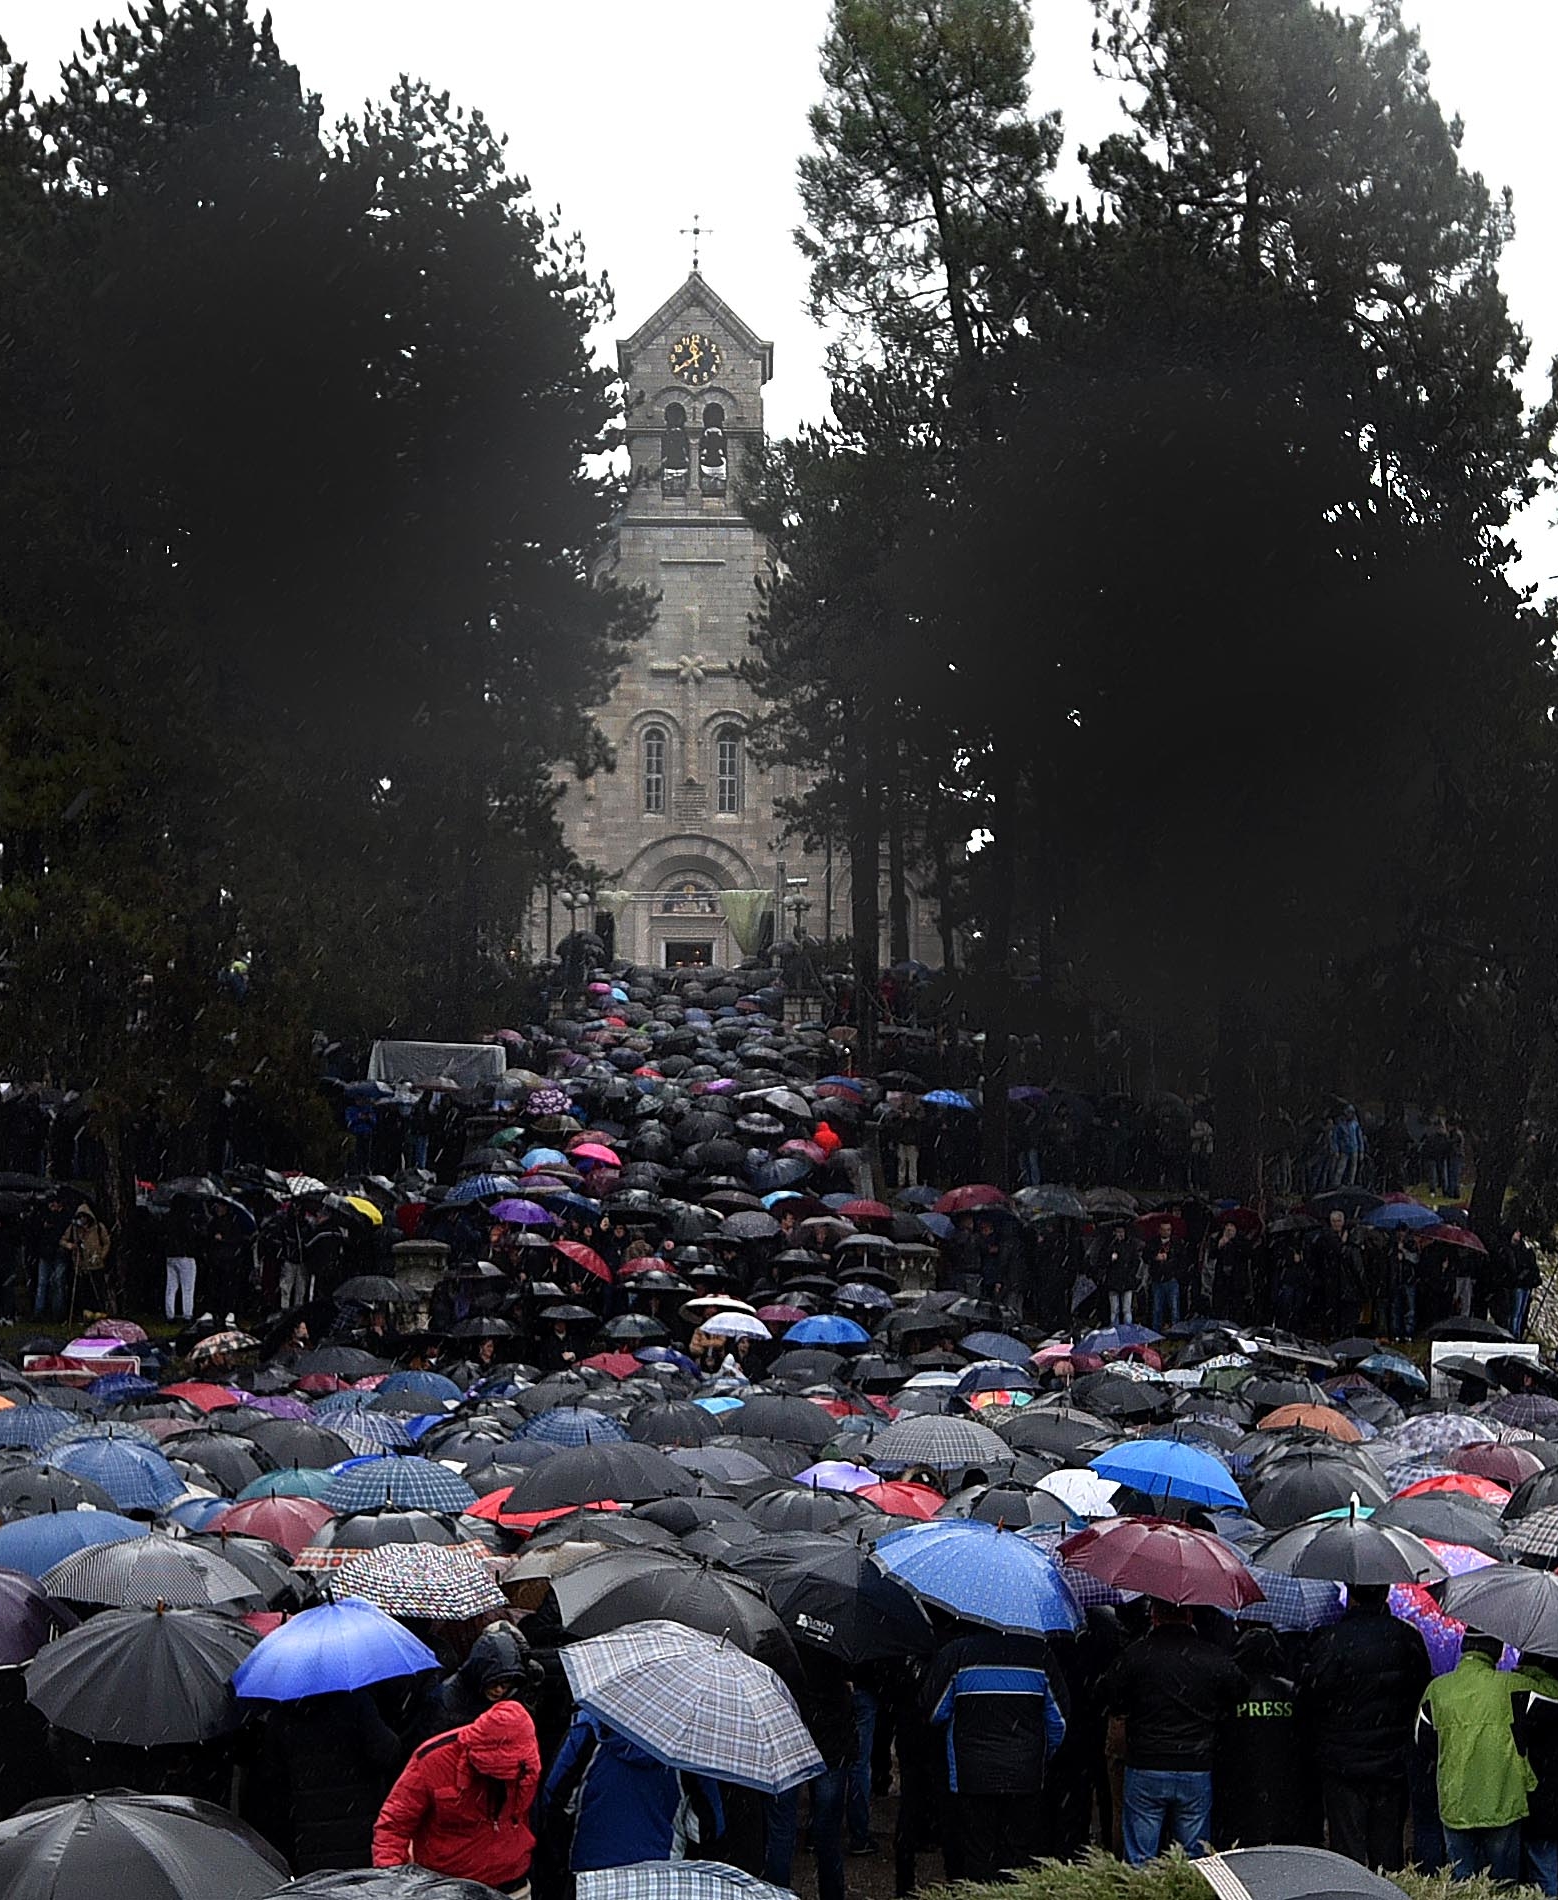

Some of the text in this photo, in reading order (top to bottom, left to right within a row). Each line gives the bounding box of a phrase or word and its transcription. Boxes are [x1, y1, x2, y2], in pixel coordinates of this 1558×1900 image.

[674, 344, 683, 353] 10
[711, 344, 716, 353] 2
[670, 354, 676, 363] 9
[714, 354, 720, 363] 3
[692, 374, 698, 383] 6
[1236, 1701, 1293, 1717] PRESS
